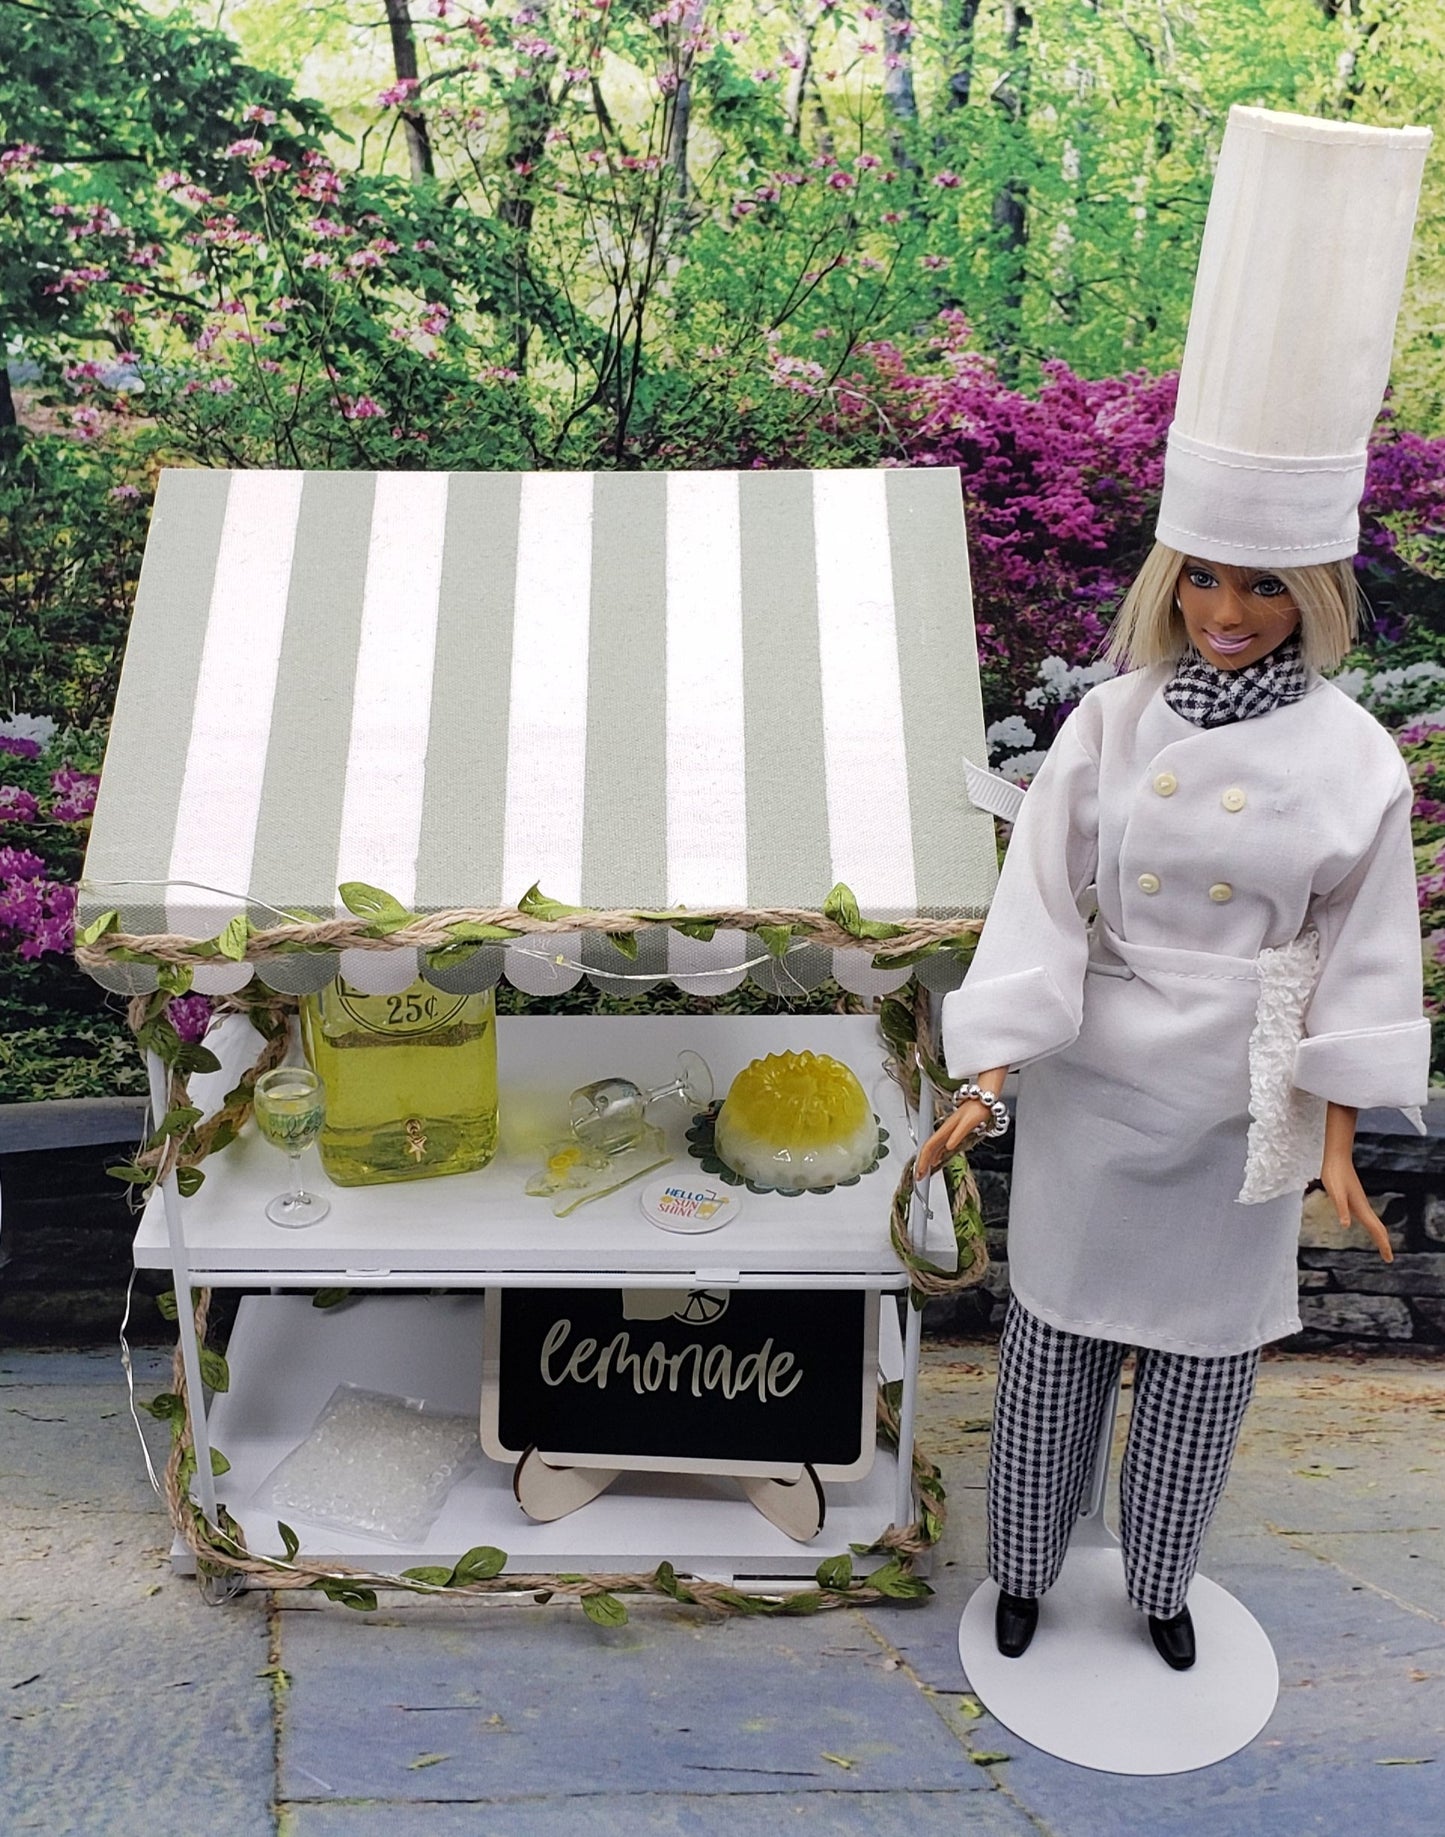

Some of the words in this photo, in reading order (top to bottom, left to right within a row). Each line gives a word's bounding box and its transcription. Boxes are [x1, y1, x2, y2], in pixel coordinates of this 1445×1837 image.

[386, 994, 439, 1025] 25¢
[665, 1187, 704, 1202] HELLO
[659, 1203, 693, 1218] SHINE
[674, 1198, 699, 1210] SUN
[540, 1319, 803, 1403] lemonade
